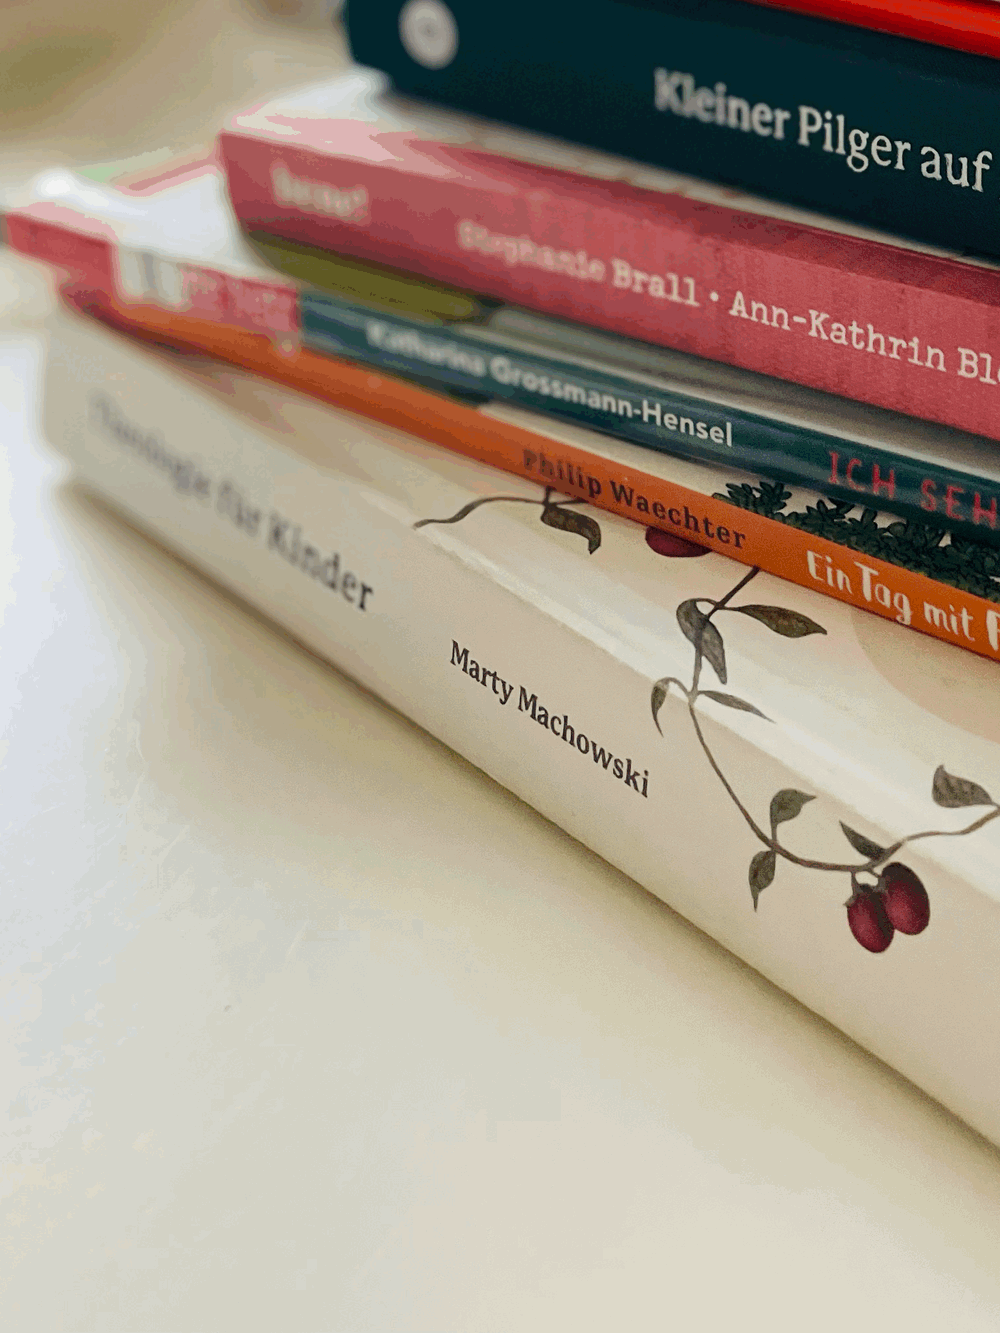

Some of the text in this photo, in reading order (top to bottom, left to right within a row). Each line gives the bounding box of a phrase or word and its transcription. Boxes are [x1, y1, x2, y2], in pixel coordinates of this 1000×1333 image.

[654, 68, 790, 139] Kleiner
[798, 104, 911, 173] Pilger
[921, 144, 992, 193] auf
[612, 258, 699, 307] Brall
[729, 291, 946, 372] Ann-Kathrin
[490, 356, 732, 448] Grossmann-Hensel
[829, 451, 897, 498] ICH
[523, 449, 748, 550] Philip Waechter
[267, 510, 374, 612] Kinder
[806, 549, 851, 596] Ein
[855, 561, 912, 627] Tag
[924, 602, 974, 644] mit
[451, 640, 649, 798] Marty Machowski
